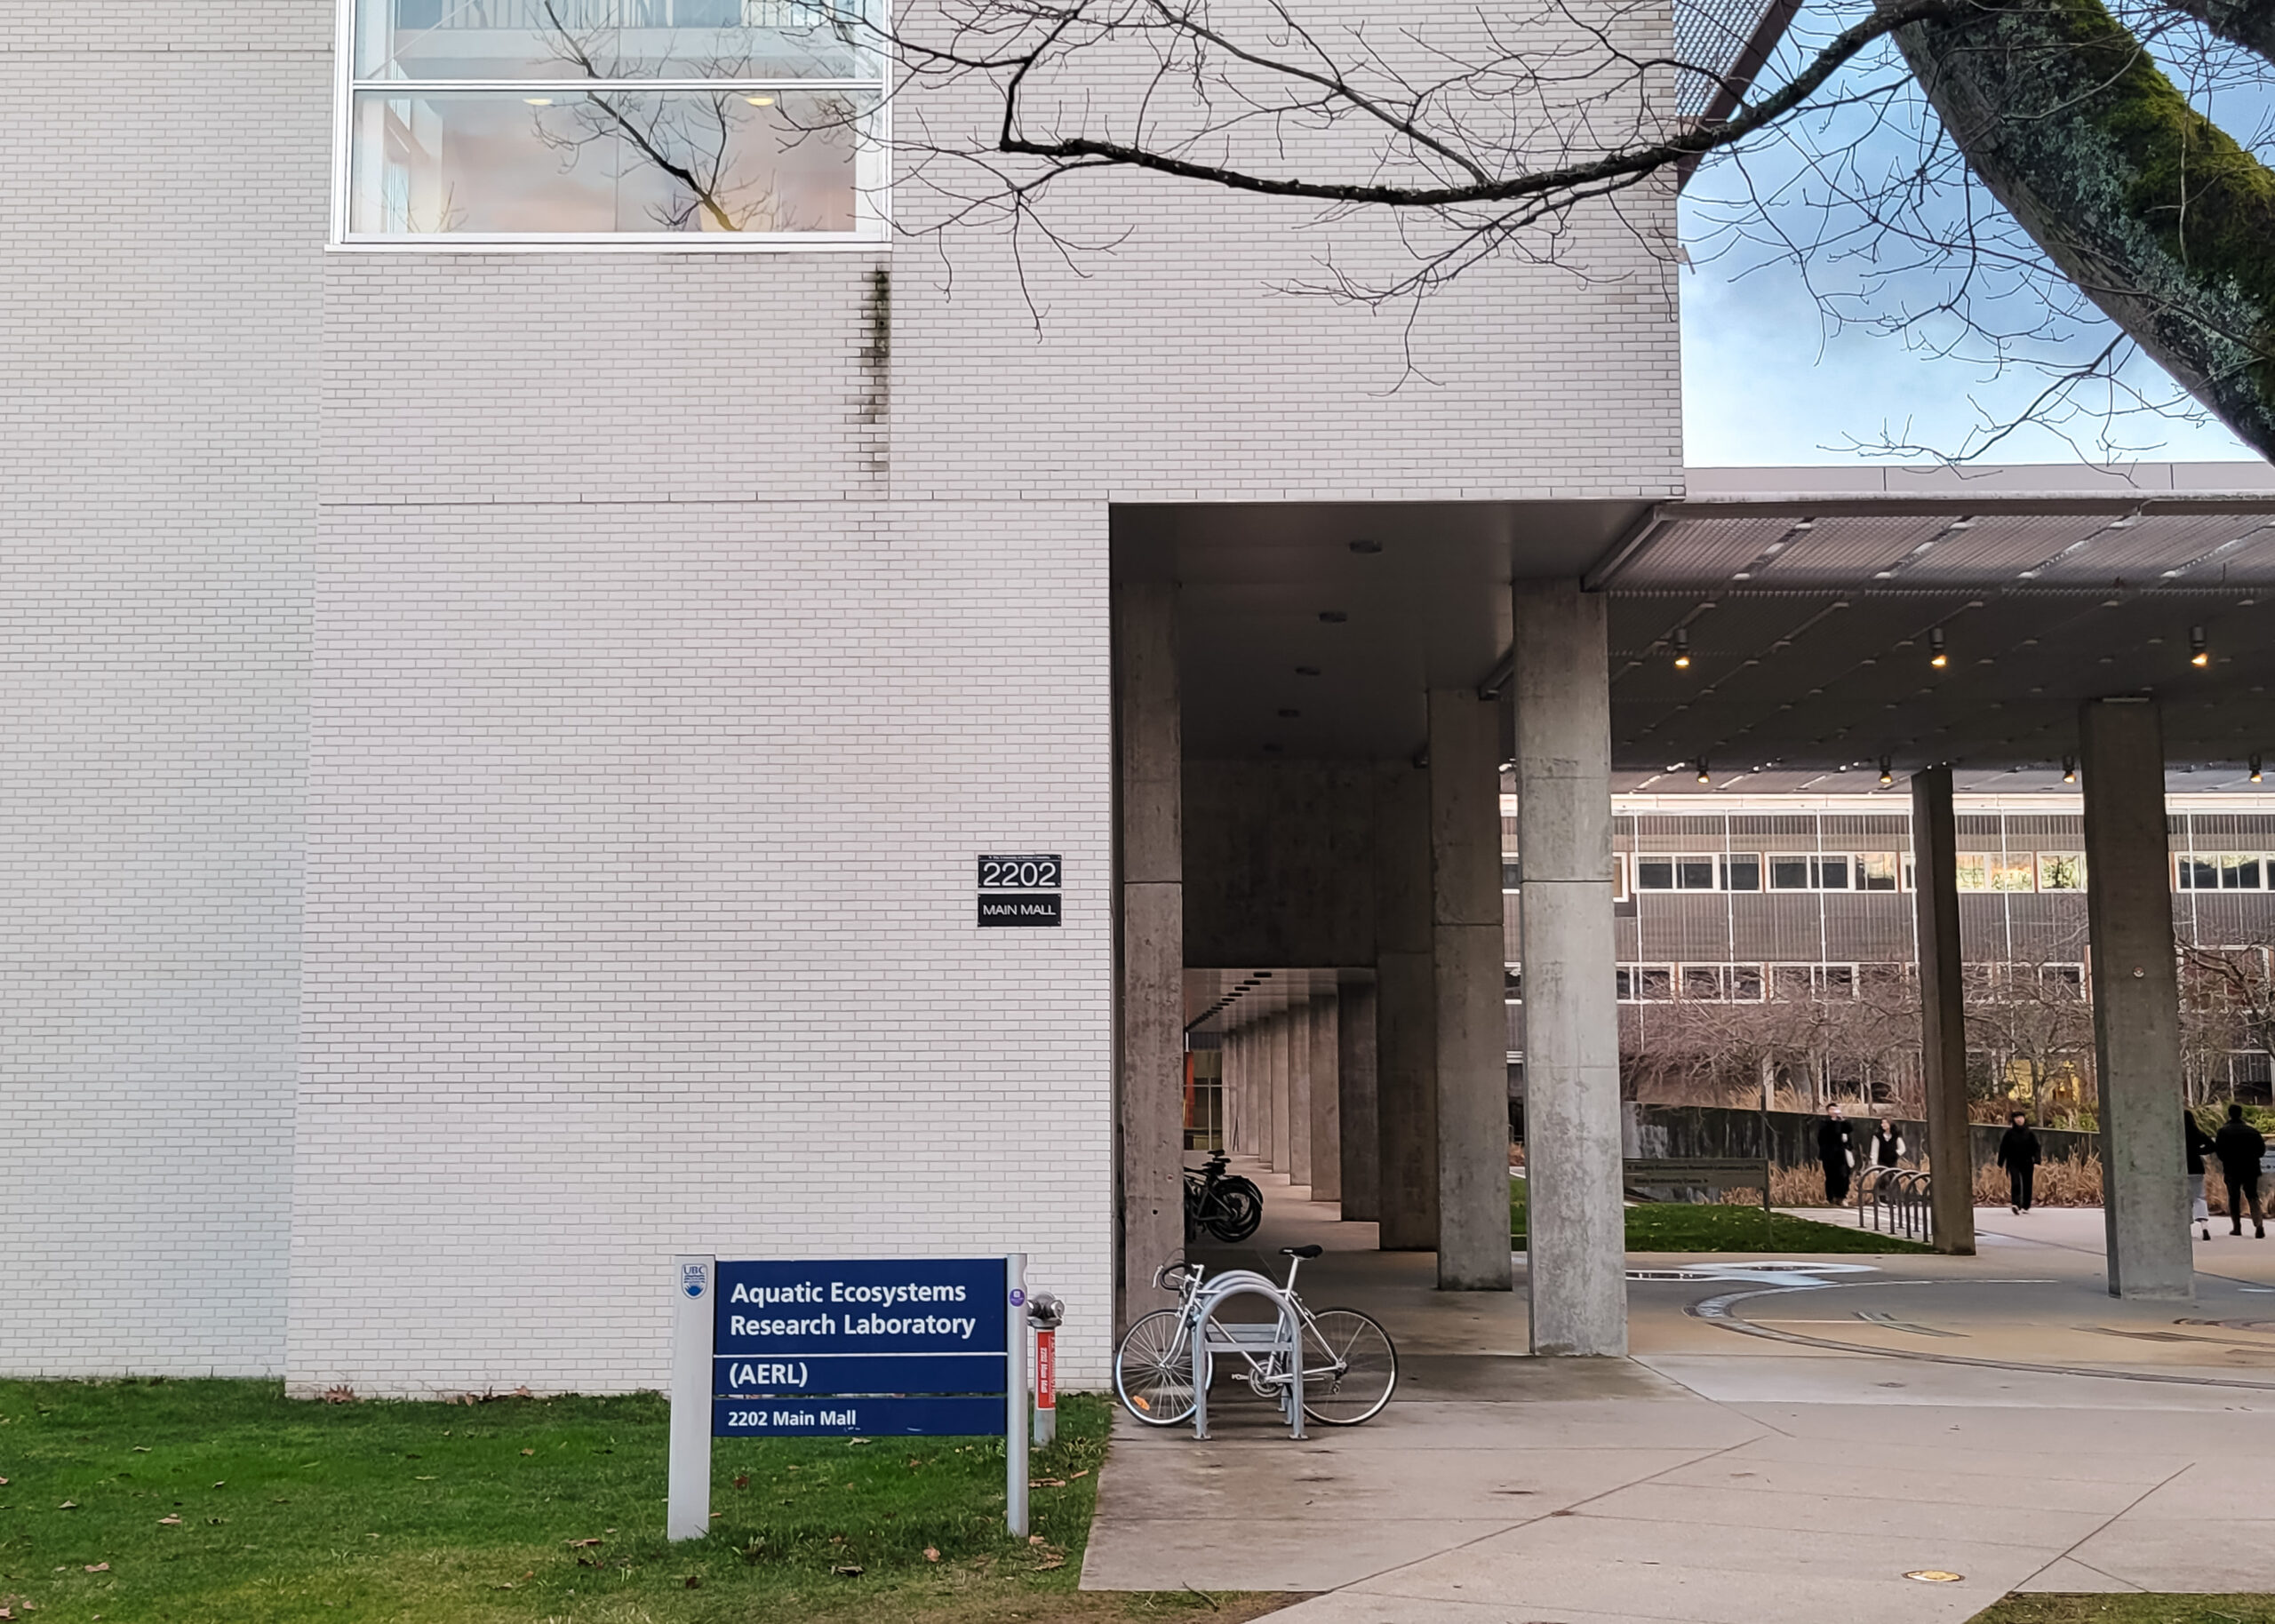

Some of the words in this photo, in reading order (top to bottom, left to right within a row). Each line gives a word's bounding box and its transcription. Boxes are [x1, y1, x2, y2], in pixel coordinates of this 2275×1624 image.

[983, 862, 1057, 887] 2202
[983, 904, 1018, 915] MAIN
[1020, 904, 1057, 915] MALL
[683, 1266, 706, 1275] UBC
[730, 1281, 824, 1308] Aquatic
[830, 1281, 967, 1308] Ecosystems
[730, 1313, 836, 1335] Research
[843, 1313, 976, 1339] Laboratory
[729, 1362, 808, 1389] (AERL)
[728, 1411, 768, 1427] 2202
[772, 1410, 815, 1426] Main
[819, 1410, 857, 1425] Mall
